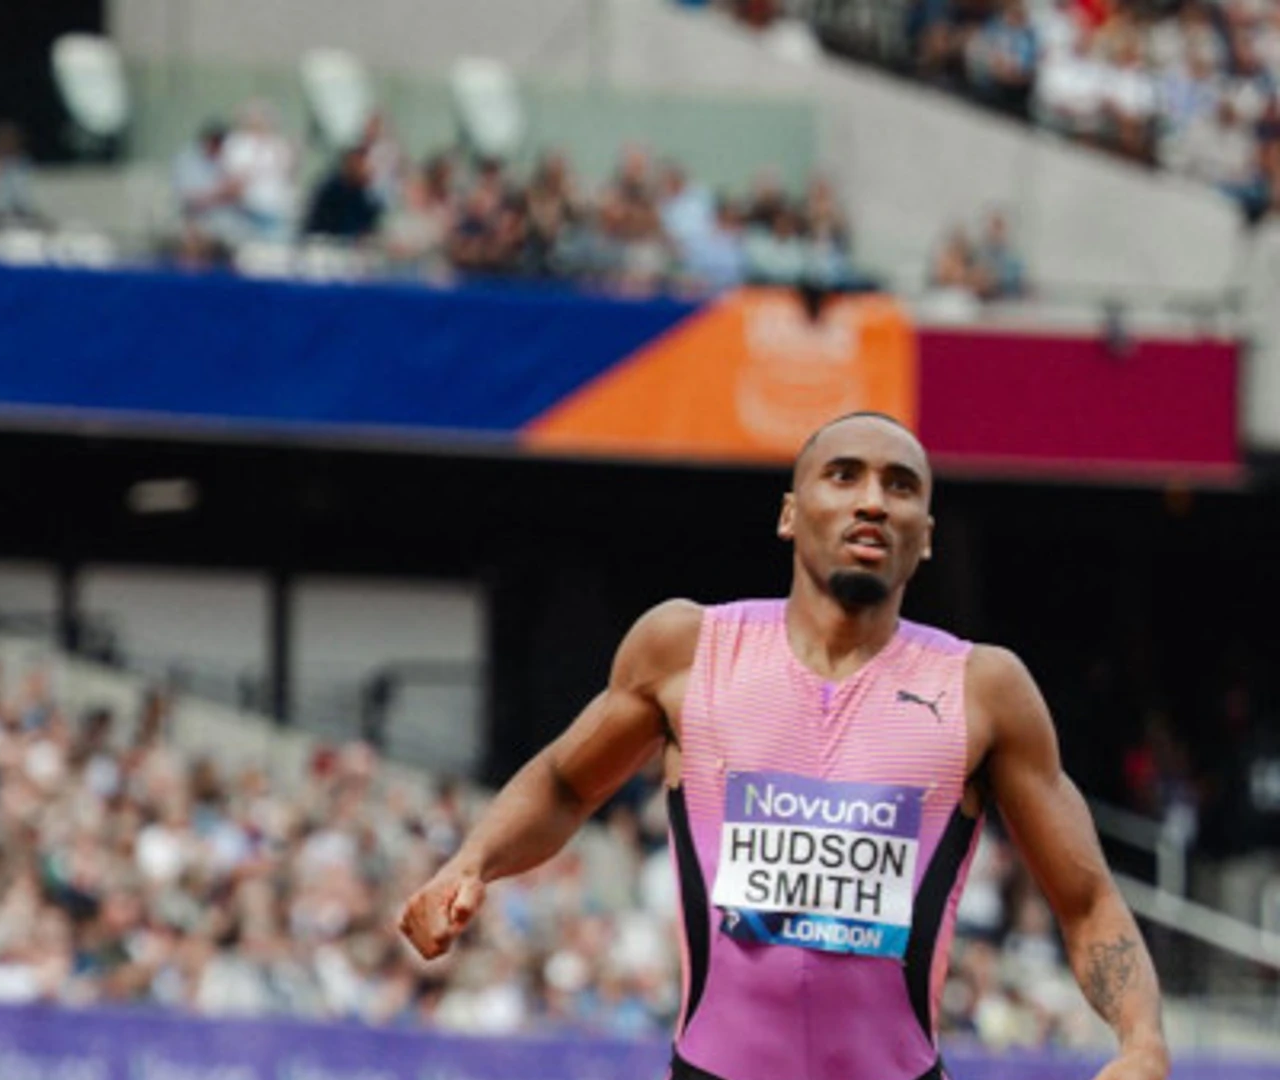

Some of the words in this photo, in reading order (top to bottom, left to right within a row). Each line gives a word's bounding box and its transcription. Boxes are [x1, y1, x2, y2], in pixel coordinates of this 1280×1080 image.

[744, 783, 898, 828] Novuna
[730, 827, 907, 878] HUDSON
[745, 869, 883, 917] SMITH
[783, 918, 884, 949] LONDON
